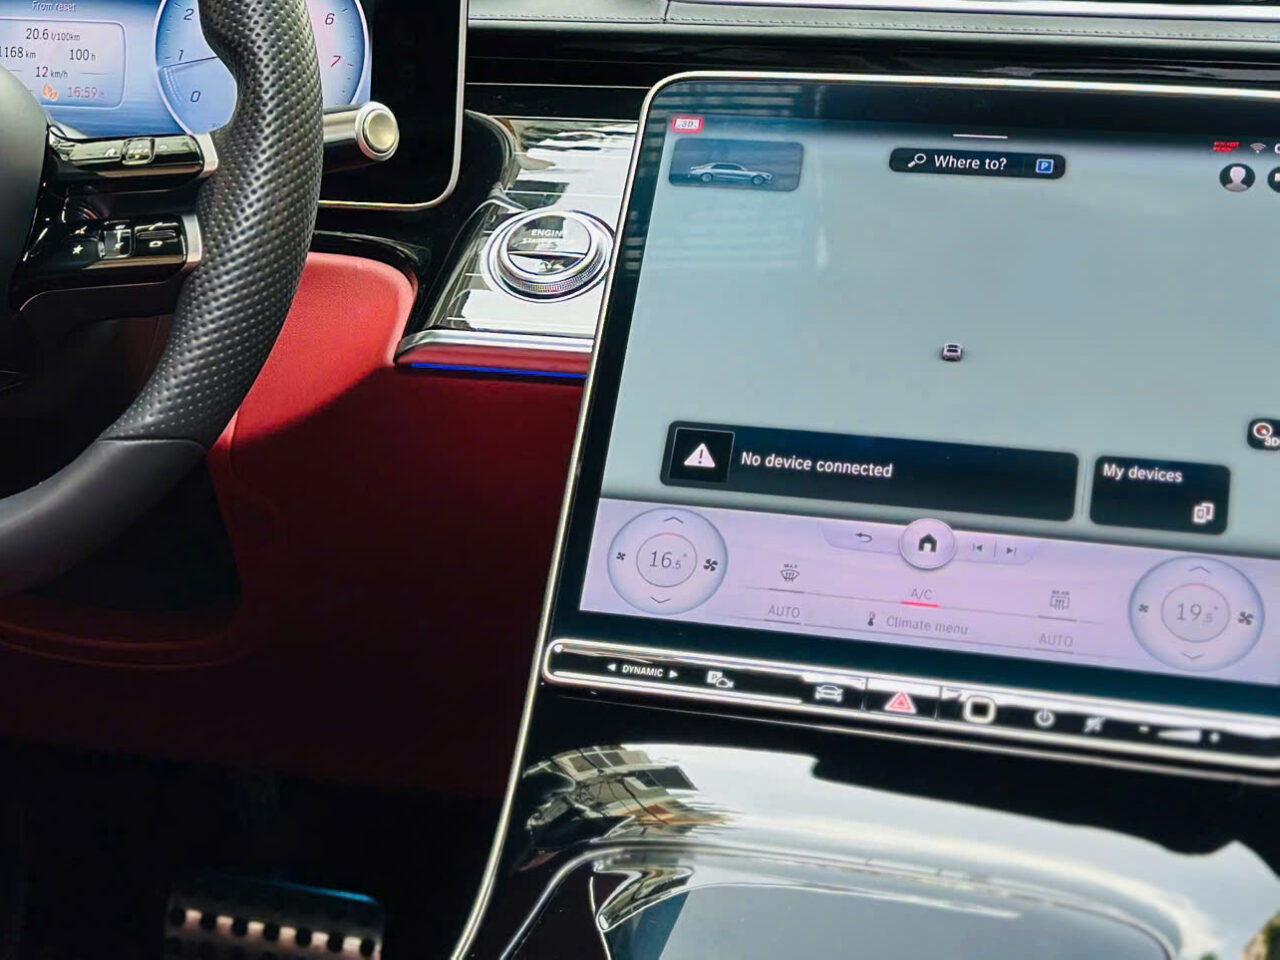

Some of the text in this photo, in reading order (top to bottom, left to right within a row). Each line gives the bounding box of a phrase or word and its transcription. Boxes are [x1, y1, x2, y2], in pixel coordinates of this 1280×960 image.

[32, 0, 76, 12] From reset
[183, 8, 194, 21] 2
[324, 12, 336, 25] 6
[25, 28, 49, 40] 20.6
[25, 50, 37, 59] km
[69, 48, 96, 61] 100 h
[178, 49, 184, 61] 1
[330, 55, 342, 67] 7
[35, 66, 68, 78] 12 km/h
[67, 86, 98, 98] 16:59
[190, 90, 201, 103] 0
[933, 154, 1007, 170] Where to?
[1264, 436, 1280, 446] 3D
[741, 451, 893, 477] No device connected
[1103, 463, 1183, 482] My devices
[910, 588, 933, 601] A/C
[768, 605, 801, 619] AUTO
[886, 616, 969, 636] Climate menu
[1039, 633, 1074, 648] AUTO
[622, 664, 664, 677] DYNAMIC
